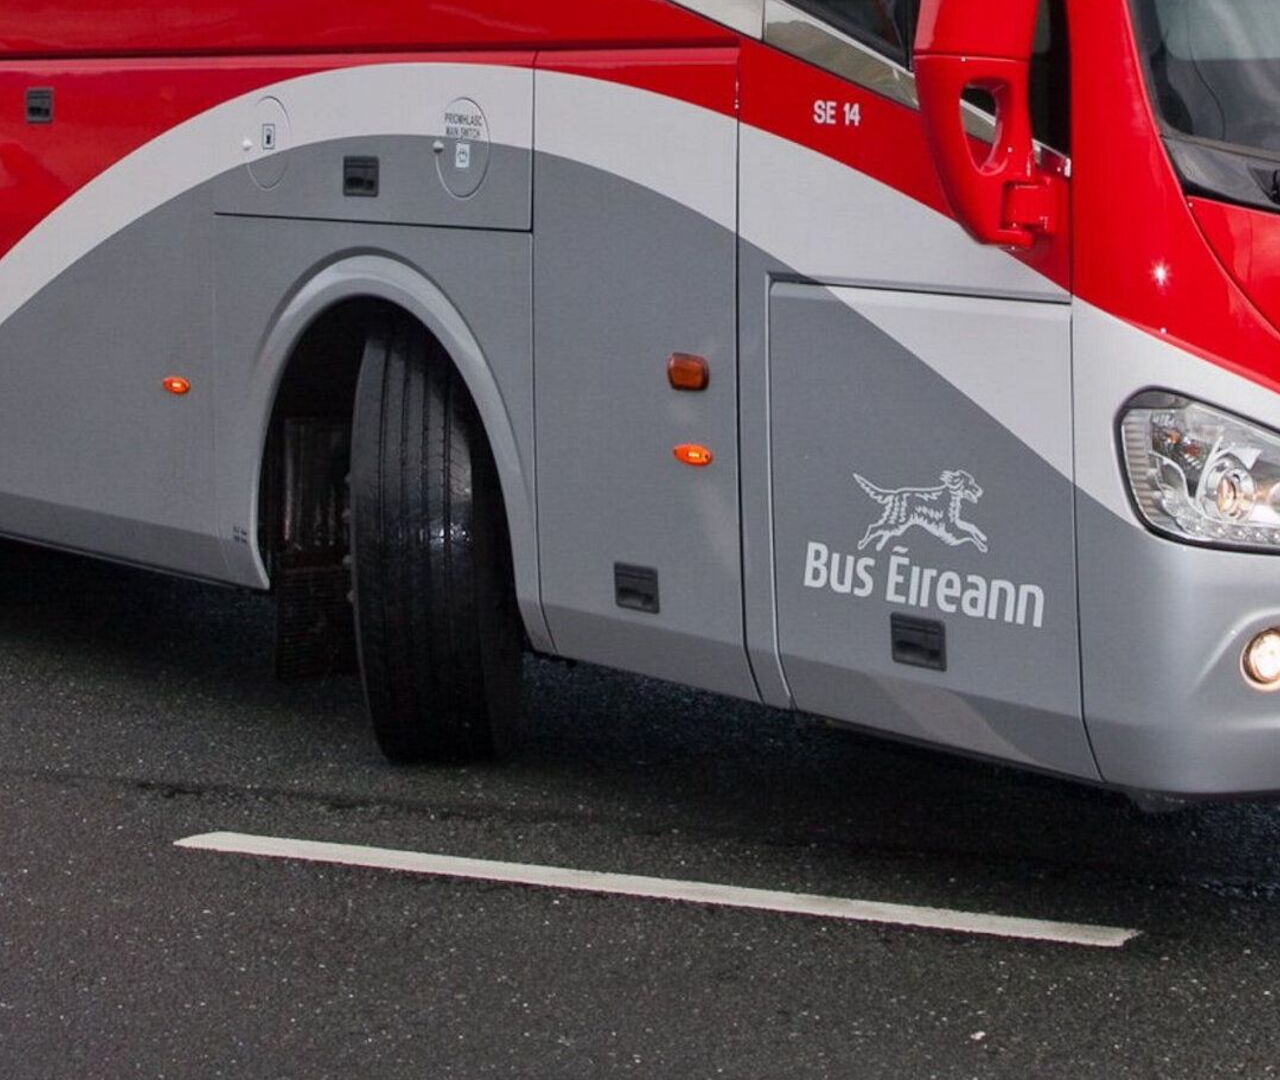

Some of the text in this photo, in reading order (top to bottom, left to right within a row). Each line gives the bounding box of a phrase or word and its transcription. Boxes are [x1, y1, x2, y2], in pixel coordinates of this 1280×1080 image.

[813, 100, 861, 127] SE 14
[803, 540, 1045, 628] Bus Éireann
